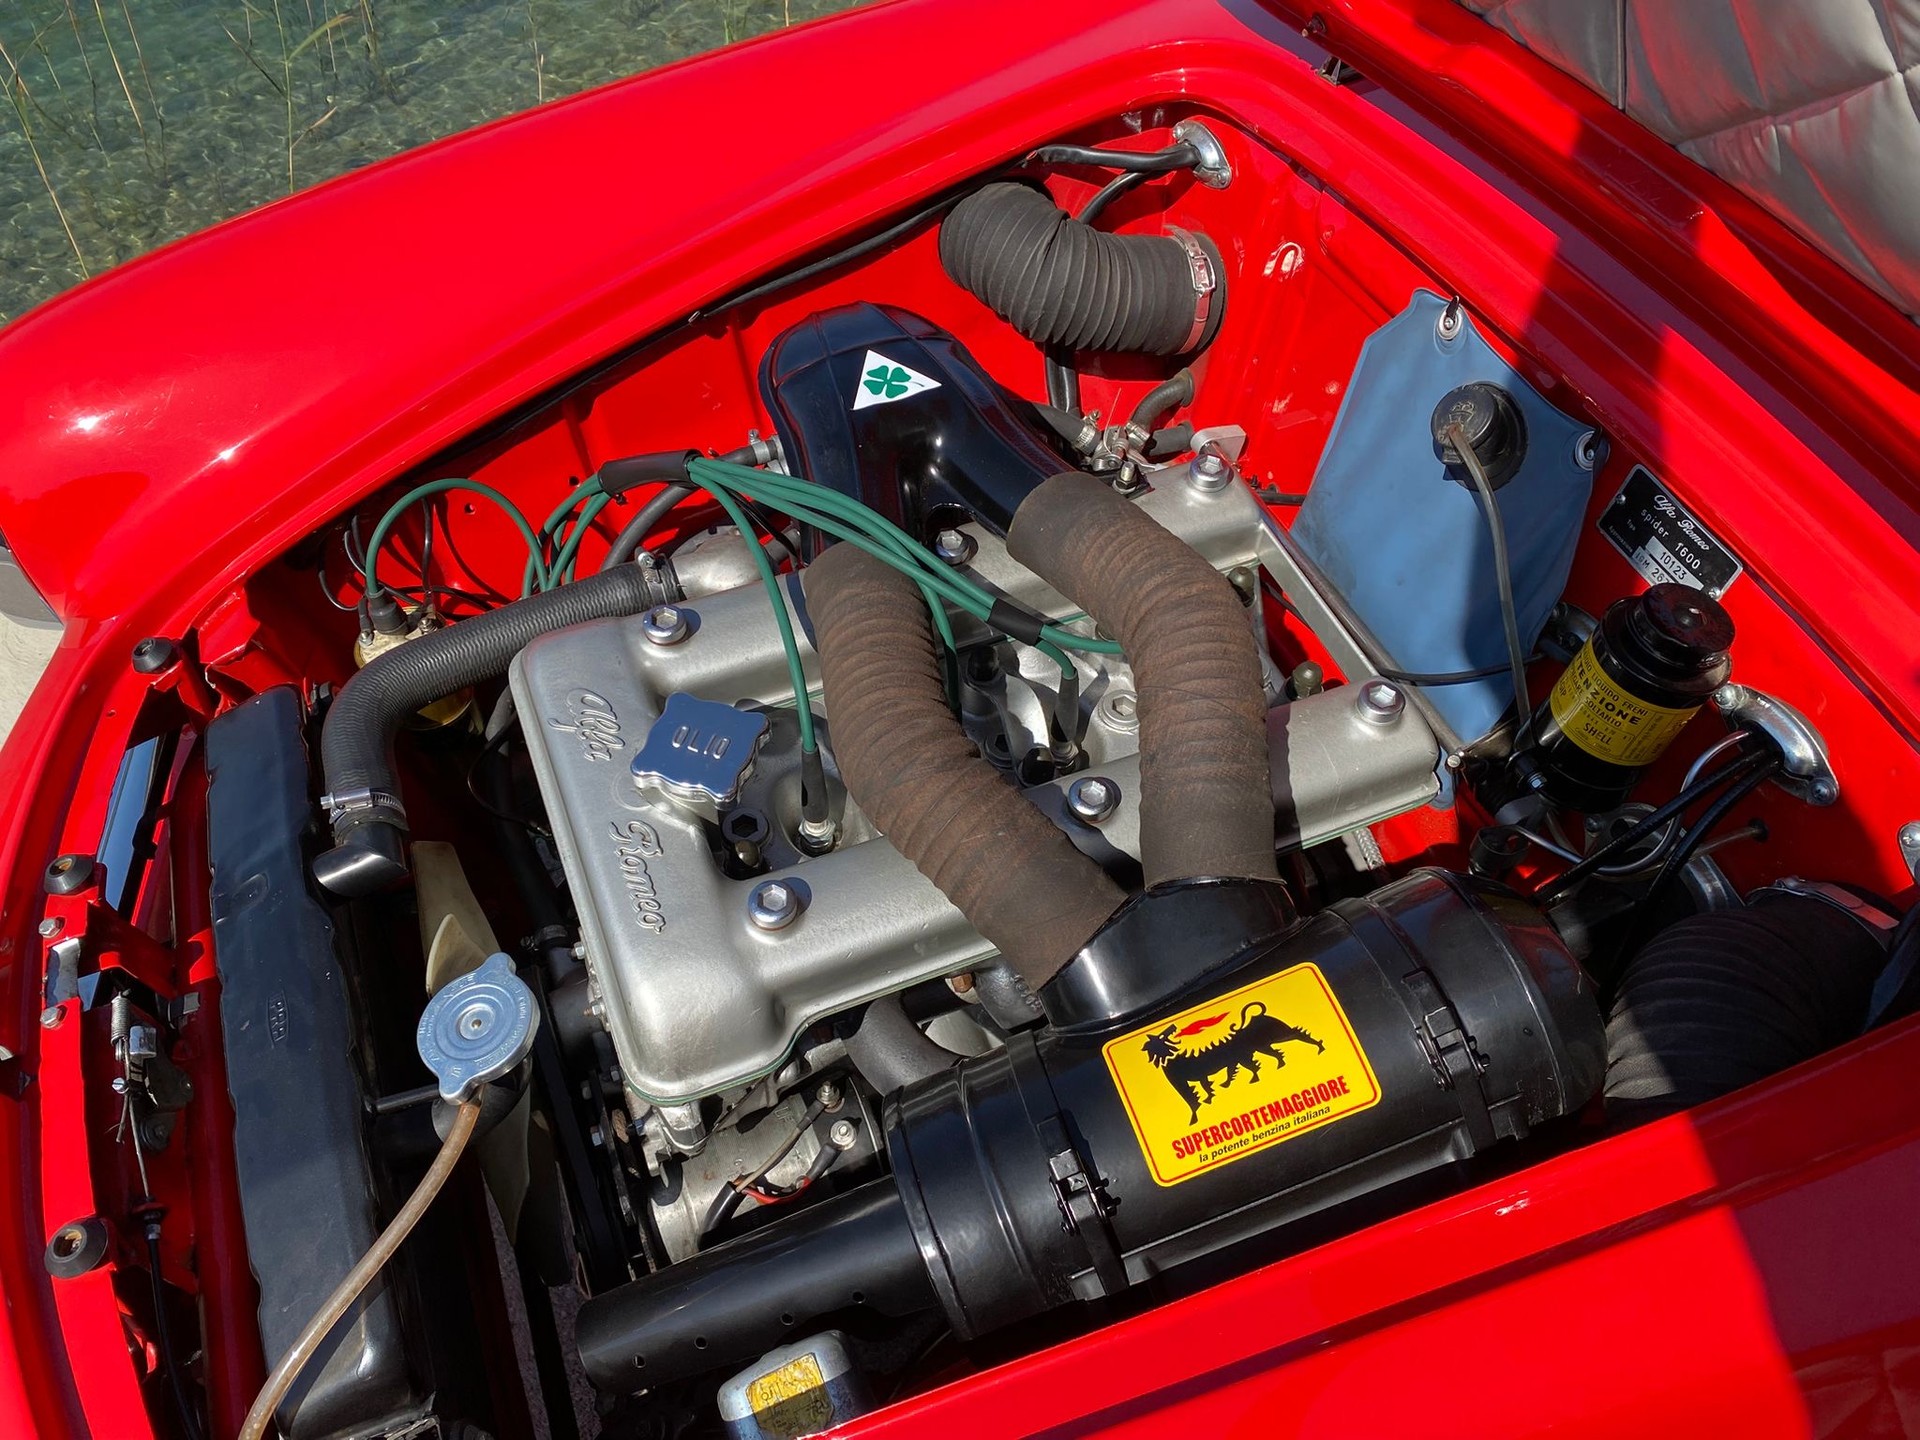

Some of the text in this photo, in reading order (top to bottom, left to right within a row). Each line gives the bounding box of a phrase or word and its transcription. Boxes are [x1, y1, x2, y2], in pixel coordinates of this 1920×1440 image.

[1640, 508, 1669, 538] spider
[1653, 494, 1710, 551] Alfa Romeo
[1660, 551, 1688, 580] 10123
[1584, 697, 1622, 729] SOLTANTO
[1590, 672, 1620, 702] LIQUIDO
[1621, 701, 1649, 717] FRENI
[671, 725, 732, 760] OLIO
[1583, 722, 1614, 746] SHELL
[549, 688, 666, 935] Alfa Romeo
[1171, 1075, 1351, 1160] SUPERCORTEMAGGIORE
[1199, 1105, 1331, 1164] la potente benzina italiana
